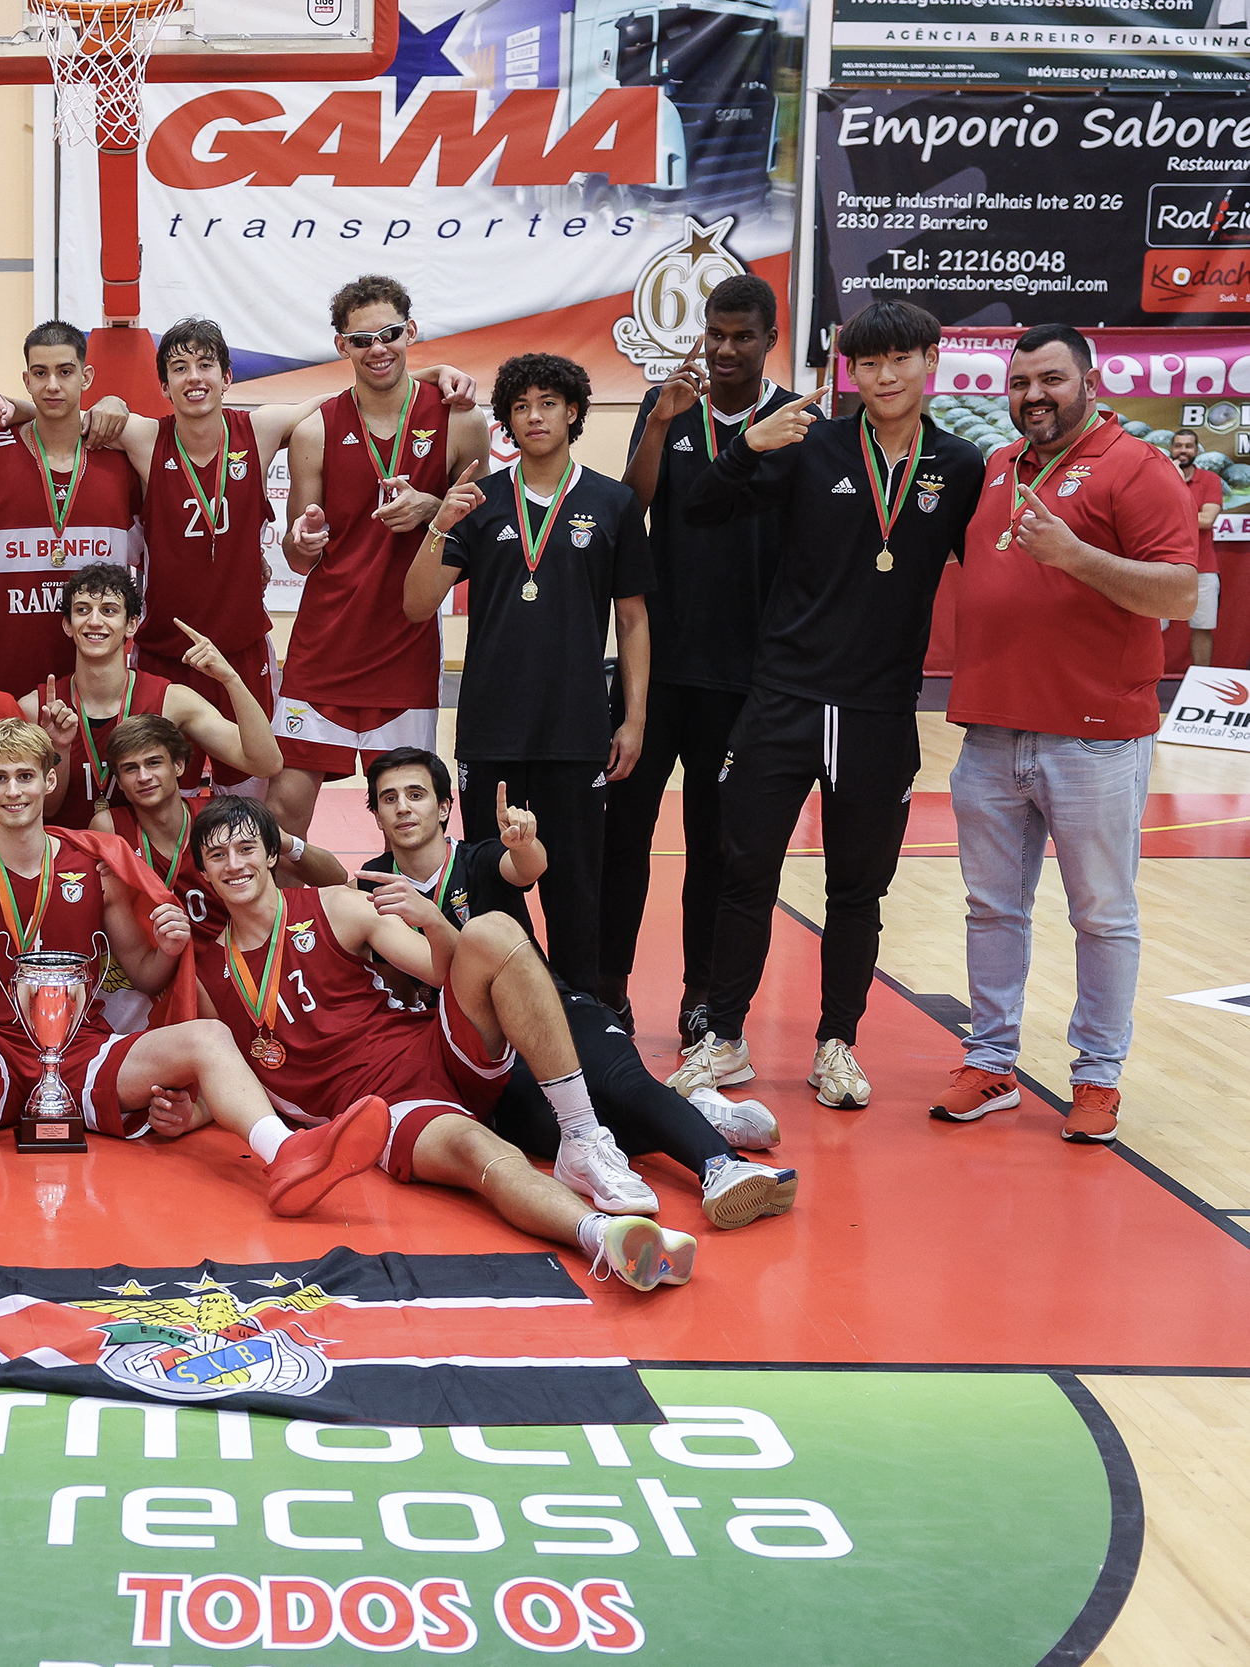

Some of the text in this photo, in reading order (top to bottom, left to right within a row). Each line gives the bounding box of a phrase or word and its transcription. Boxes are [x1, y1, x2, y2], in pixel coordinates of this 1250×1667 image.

[886, 28, 977, 42] AGÊNCIA
[990, 31, 1095, 44] BARREIRO
[1027, 64, 1166, 80] IMÓVEIS QUE MARCAM
[145, 86, 659, 190] GAMA
[836, 103, 1060, 163] Emporio
[836, 190, 892, 213] Parque
[895, 191, 973, 210] industrial
[975, 192, 1034, 211] Palhais
[1036, 193, 1070, 211] lote
[1073, 193, 1097, 211] 20
[169, 212, 635, 246] transportes
[836, 212, 989, 231] 2830 222 Barreiro
[887, 248, 1066, 273] Tel: 212168048
[841, 272, 1109, 296] geralemporiosabores@gmail.com
[183, 496, 230, 538] 20
[5, 540, 32, 559] SL
[495, 533, 519, 542] adidas
[1172, 722, 1227, 737] Technical
[276, 968, 318, 1025] 13
[46, 1478, 856, 1561] recosta
[117, 1572, 649, 1656] TODOS OS
